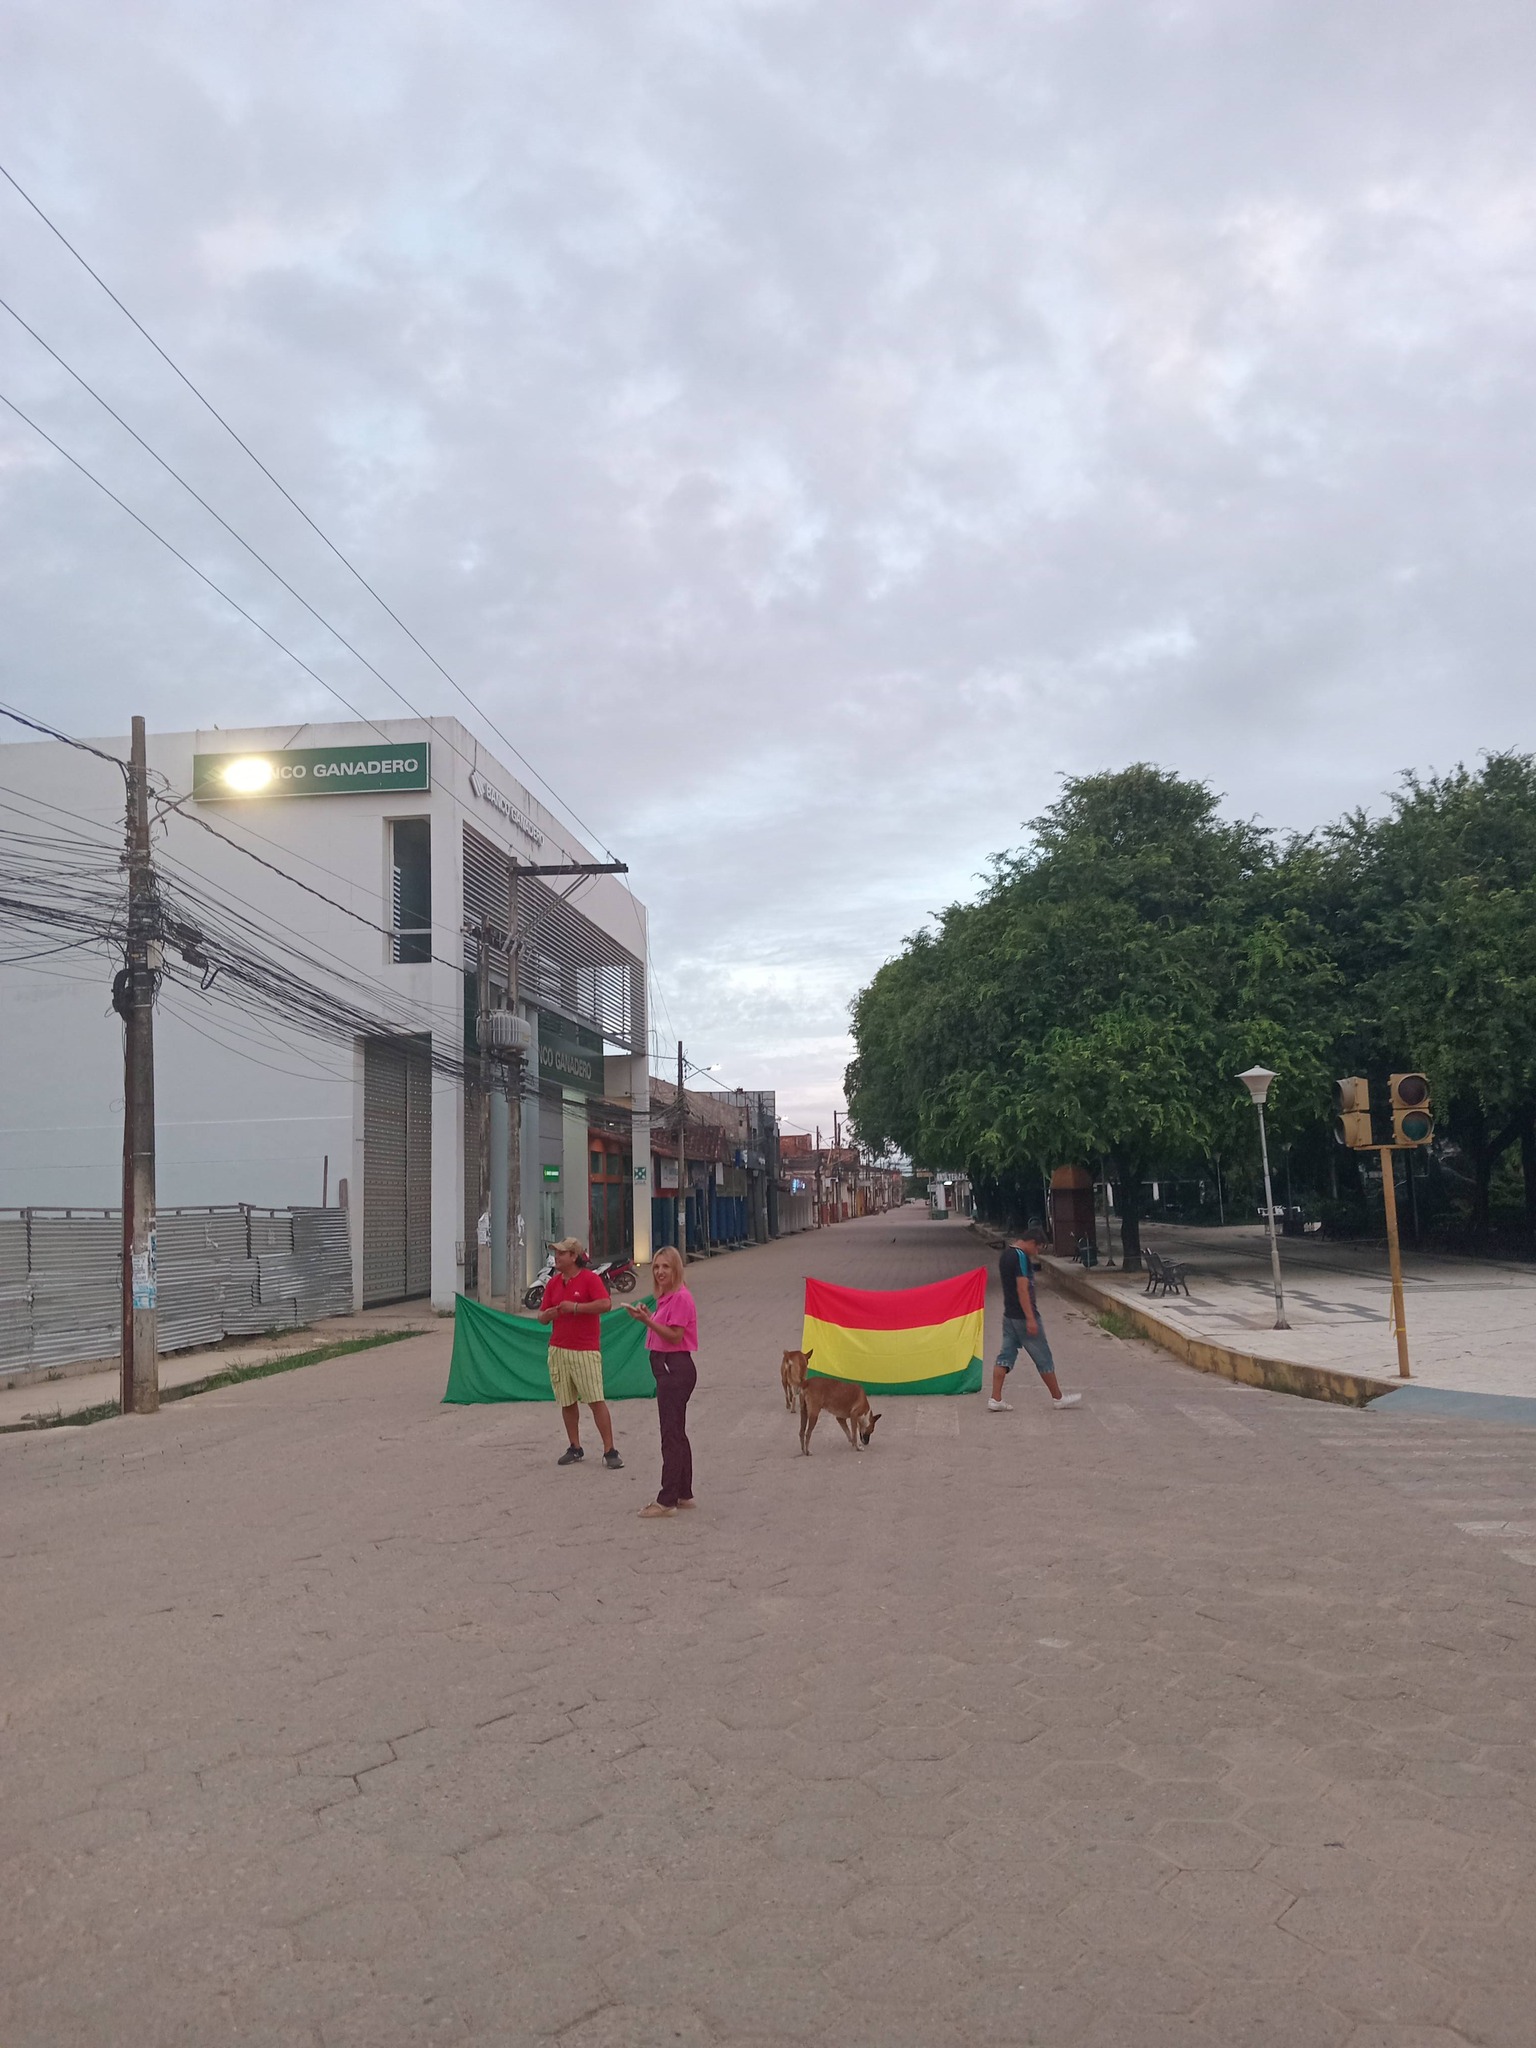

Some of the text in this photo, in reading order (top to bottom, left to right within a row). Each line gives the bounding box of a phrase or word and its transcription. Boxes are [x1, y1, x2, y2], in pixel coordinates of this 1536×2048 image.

[313, 758, 419, 778] GANADERO
[540, 1045, 592, 1080] NCO GANADERO
